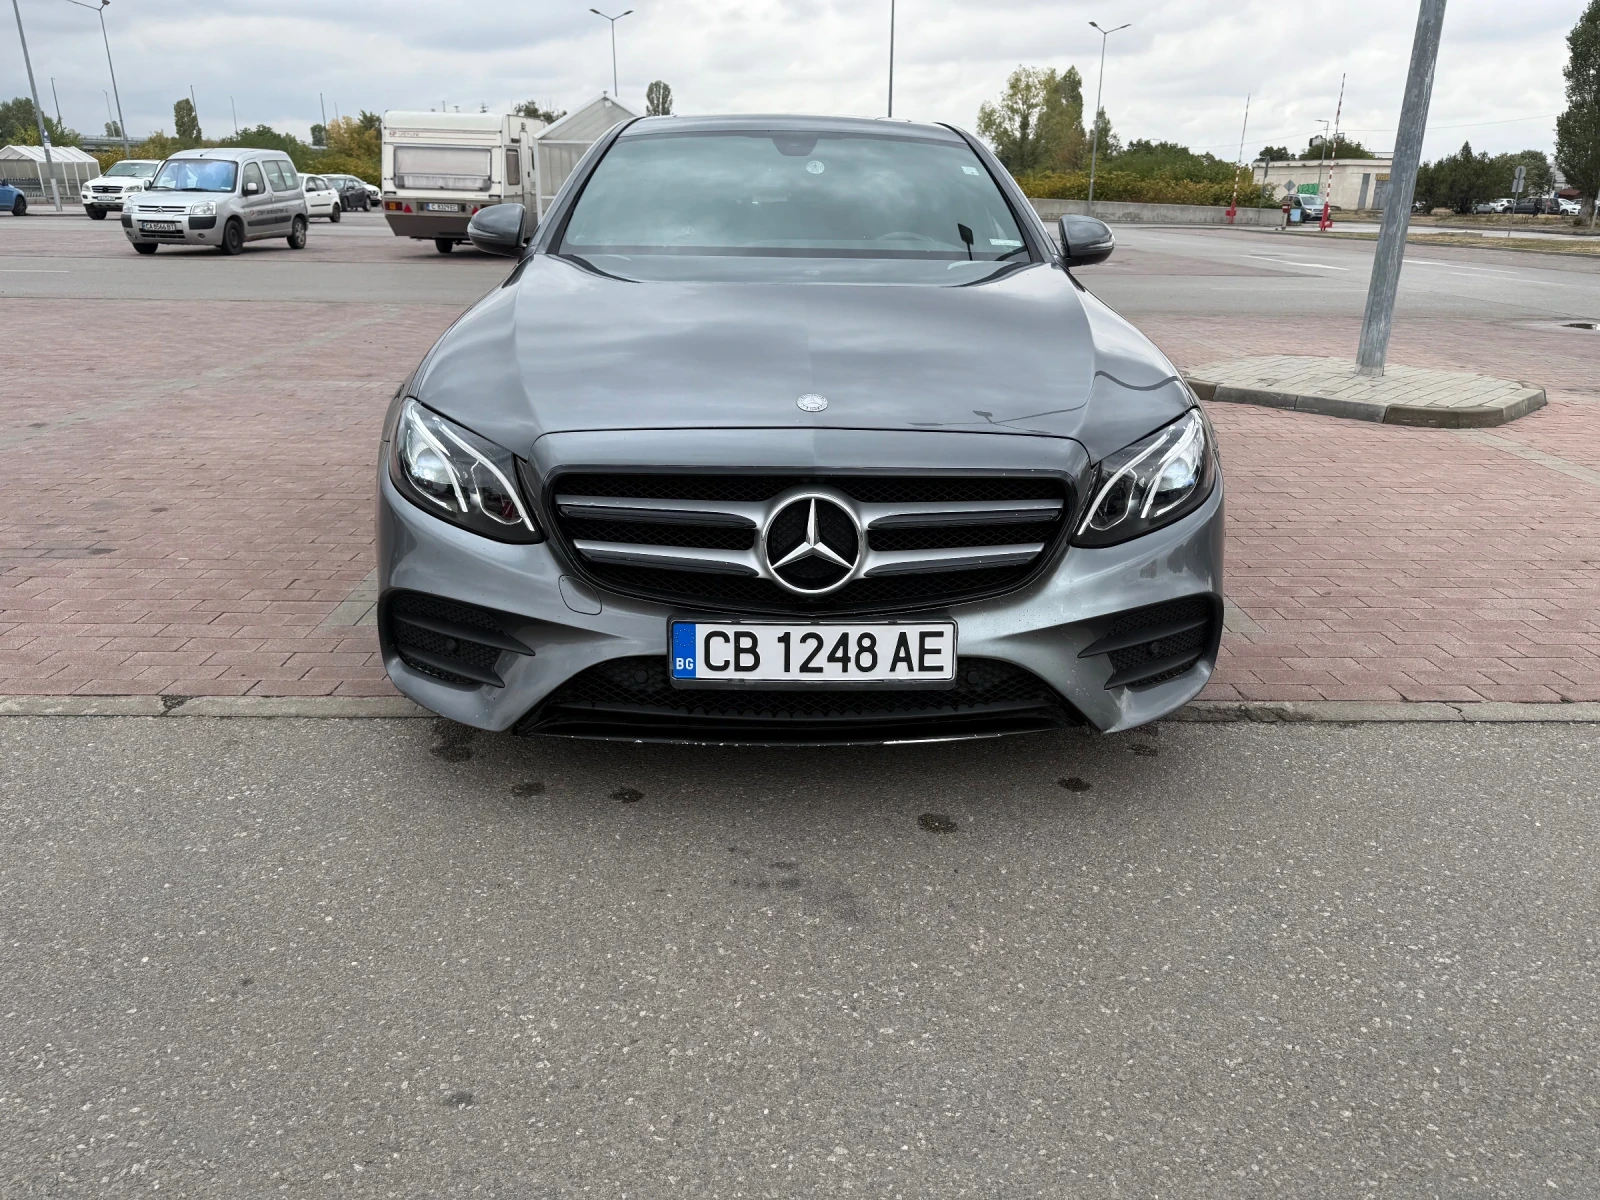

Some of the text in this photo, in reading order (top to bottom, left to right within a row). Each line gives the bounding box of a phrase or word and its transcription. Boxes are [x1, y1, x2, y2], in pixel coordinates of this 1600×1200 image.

[676, 658, 694, 670] BG
[704, 630, 945, 673] CB 1248 AE
